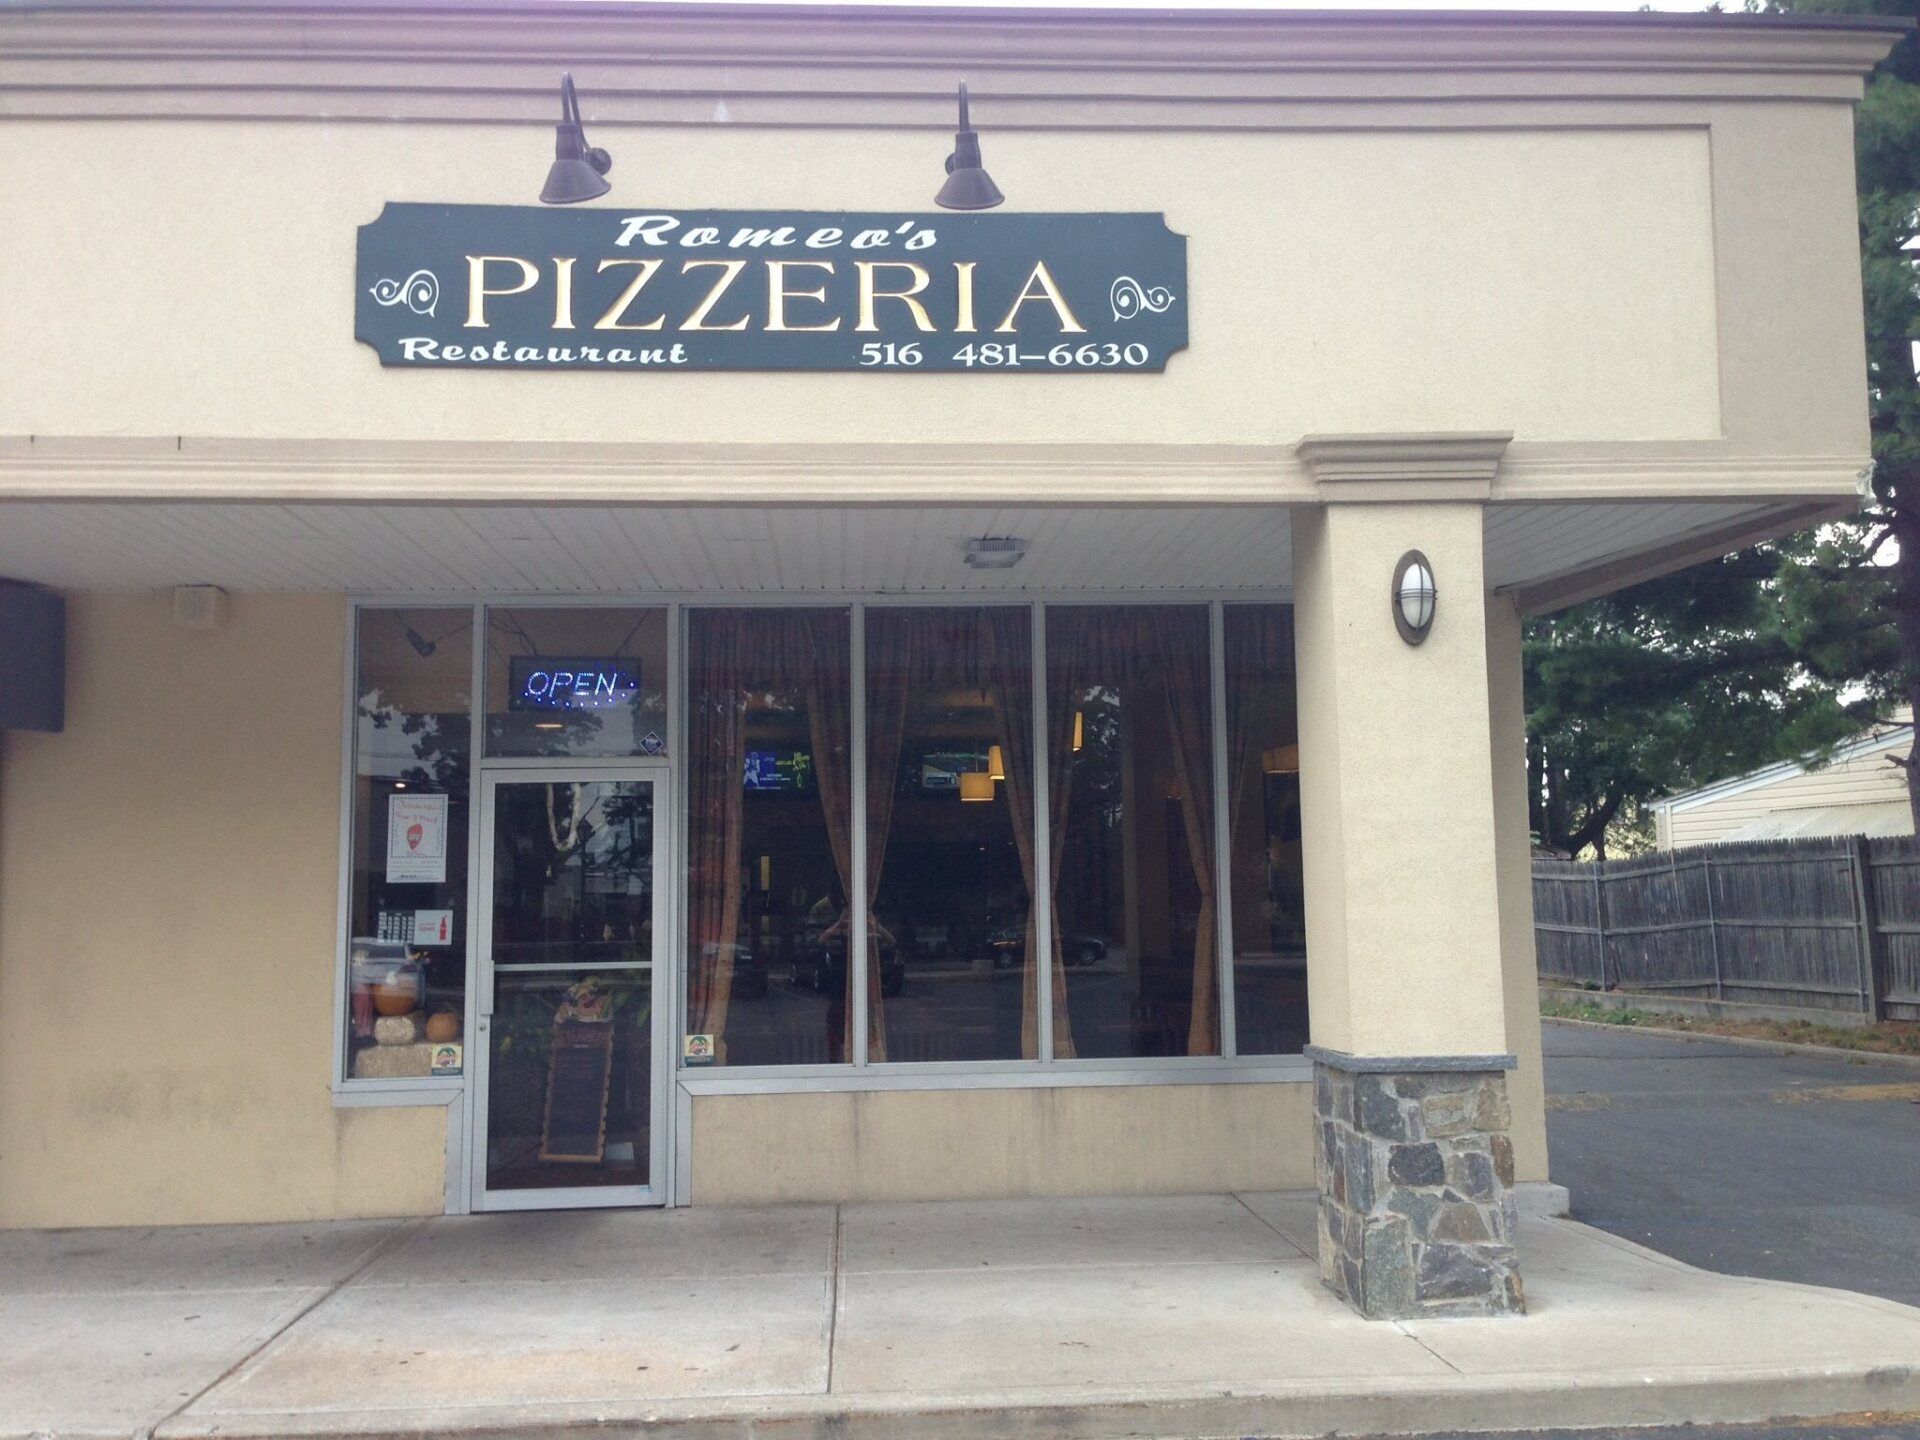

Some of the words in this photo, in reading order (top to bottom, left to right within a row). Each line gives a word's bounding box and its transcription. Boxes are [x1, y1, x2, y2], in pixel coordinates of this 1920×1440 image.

[614, 215, 937, 250] Romeo's
[463, 255, 1087, 333] PIZZERIA
[398, 336, 688, 364] Restaurant
[860, 343, 923, 366] 516
[952, 343, 1149, 367] 481-6630
[527, 672, 618, 697] OPEN
